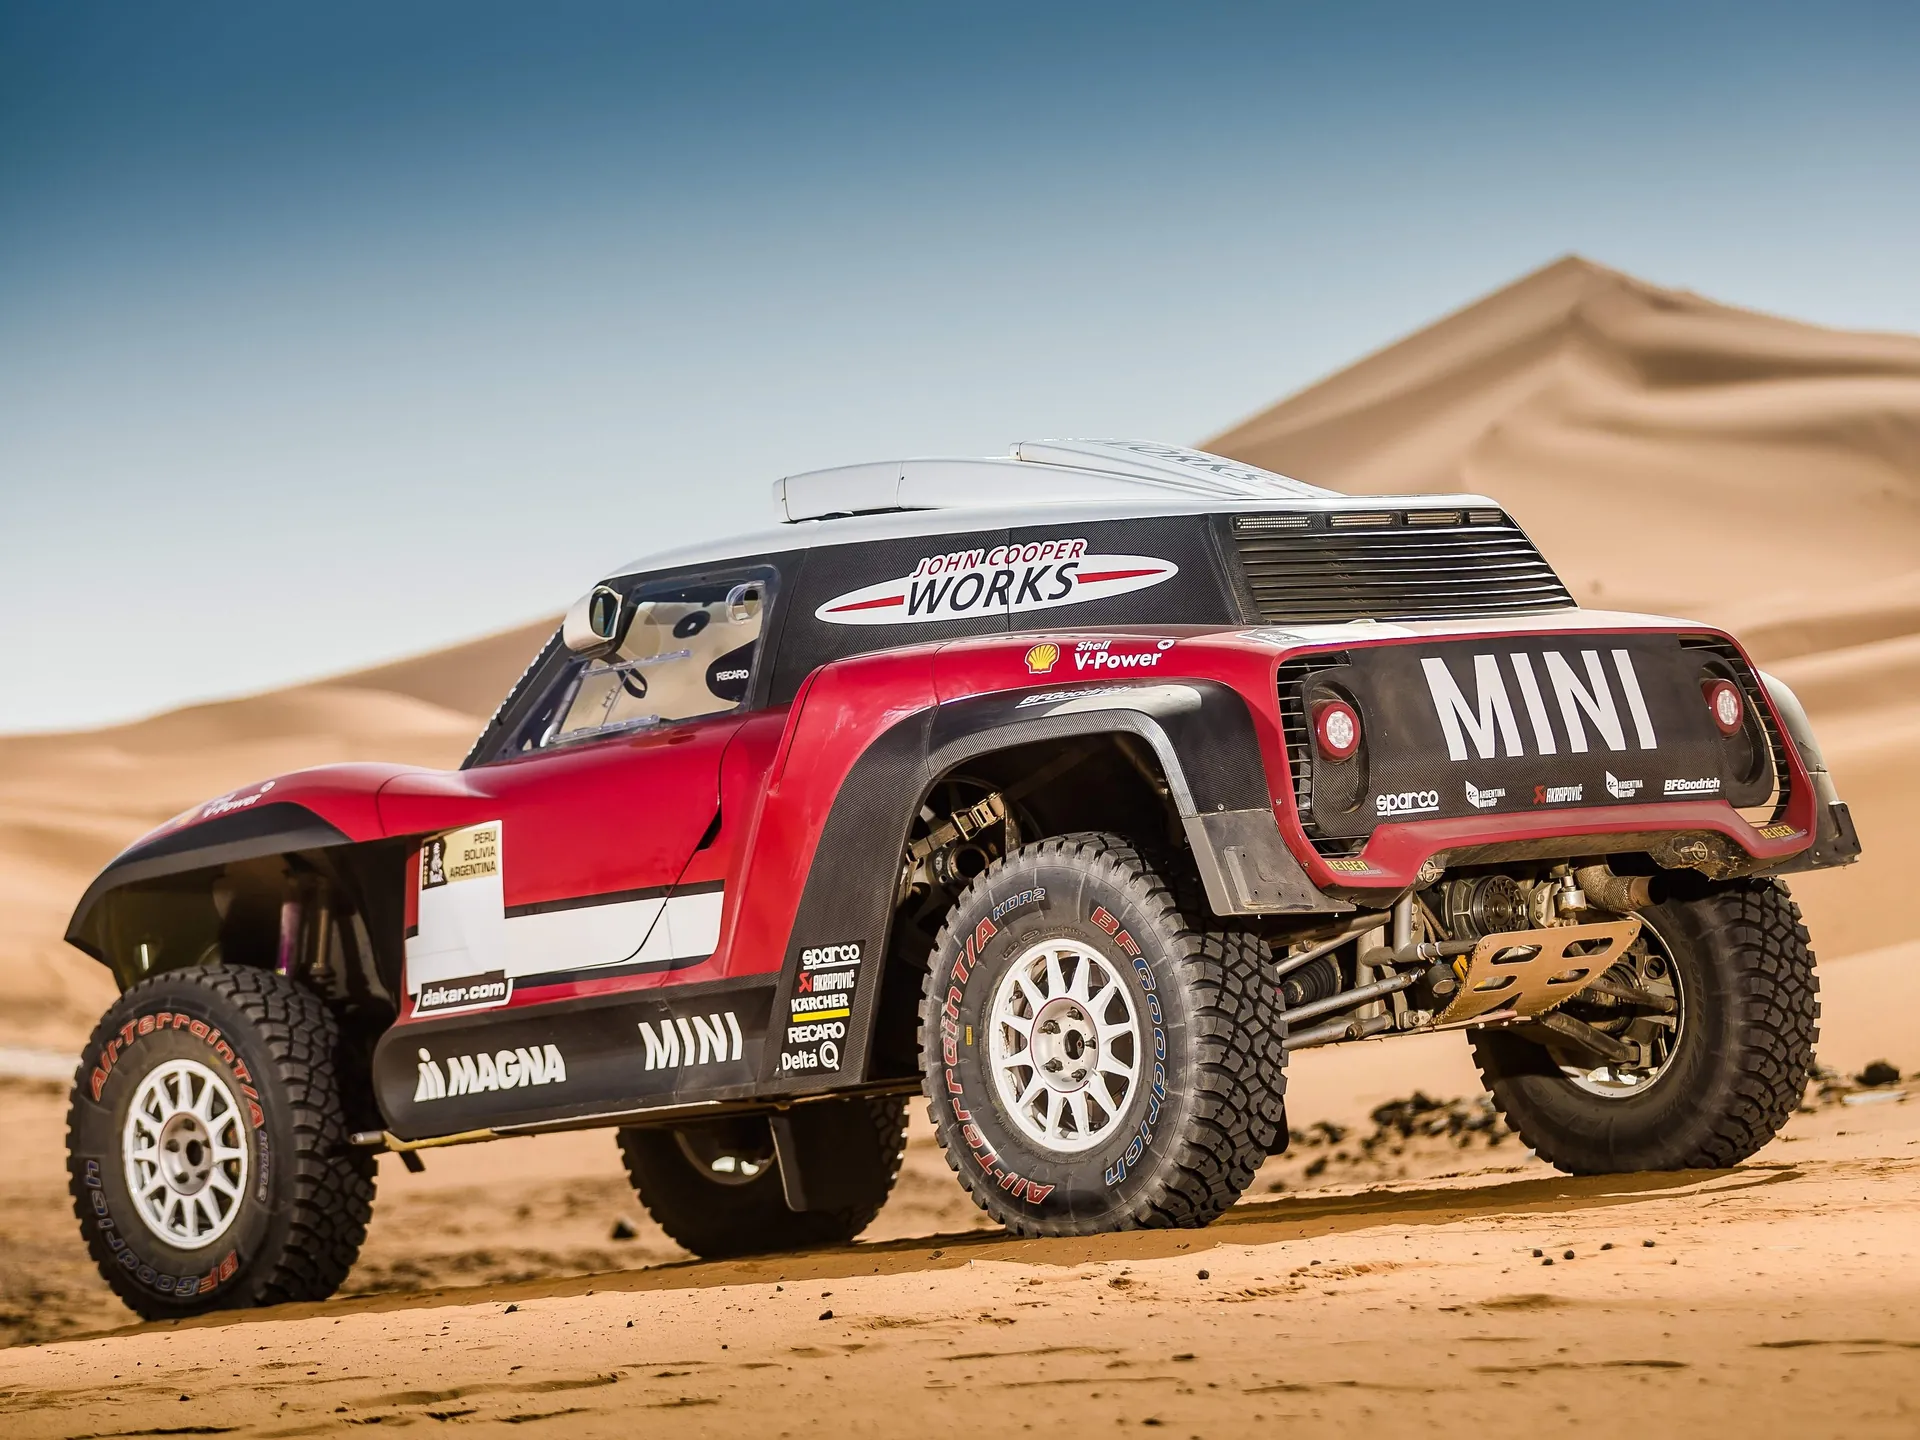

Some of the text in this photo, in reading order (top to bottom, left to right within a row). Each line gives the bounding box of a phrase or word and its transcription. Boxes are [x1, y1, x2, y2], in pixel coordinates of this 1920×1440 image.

[913, 541, 1085, 578] JOHN COOPER
[908, 562, 1078, 616] WORKS
[1076, 640, 1112, 651] Shell
[1074, 652, 1162, 670] V-Power
[716, 669, 749, 681] RECARO
[1421, 649, 1658, 761] MINI
[1479, 788, 1506, 799] ARGENTINA
[1619, 779, 1643, 789] ARGENTINA
[1664, 777, 1720, 791] BFGoodrich
[1376, 790, 1439, 816] sparco
[474, 831, 496, 844] PERU
[1758, 824, 1795, 839] REIGER
[464, 846, 496, 861] BOLIVIA
[449, 861, 496, 878] ARGENTINA
[1325, 860, 1369, 870] REIGER
[992, 888, 1046, 922] KDR2
[802, 944, 860, 970] sparco
[421, 981, 505, 1007] dakar.com
[638, 1012, 743, 1071] MINI
[788, 1022, 845, 1043] RECARO
[781, 1041, 840, 1071] Delta Q
[1090, 906, 1166, 1187] BFGoodrich
[447, 1044, 566, 1097] MAGNA
